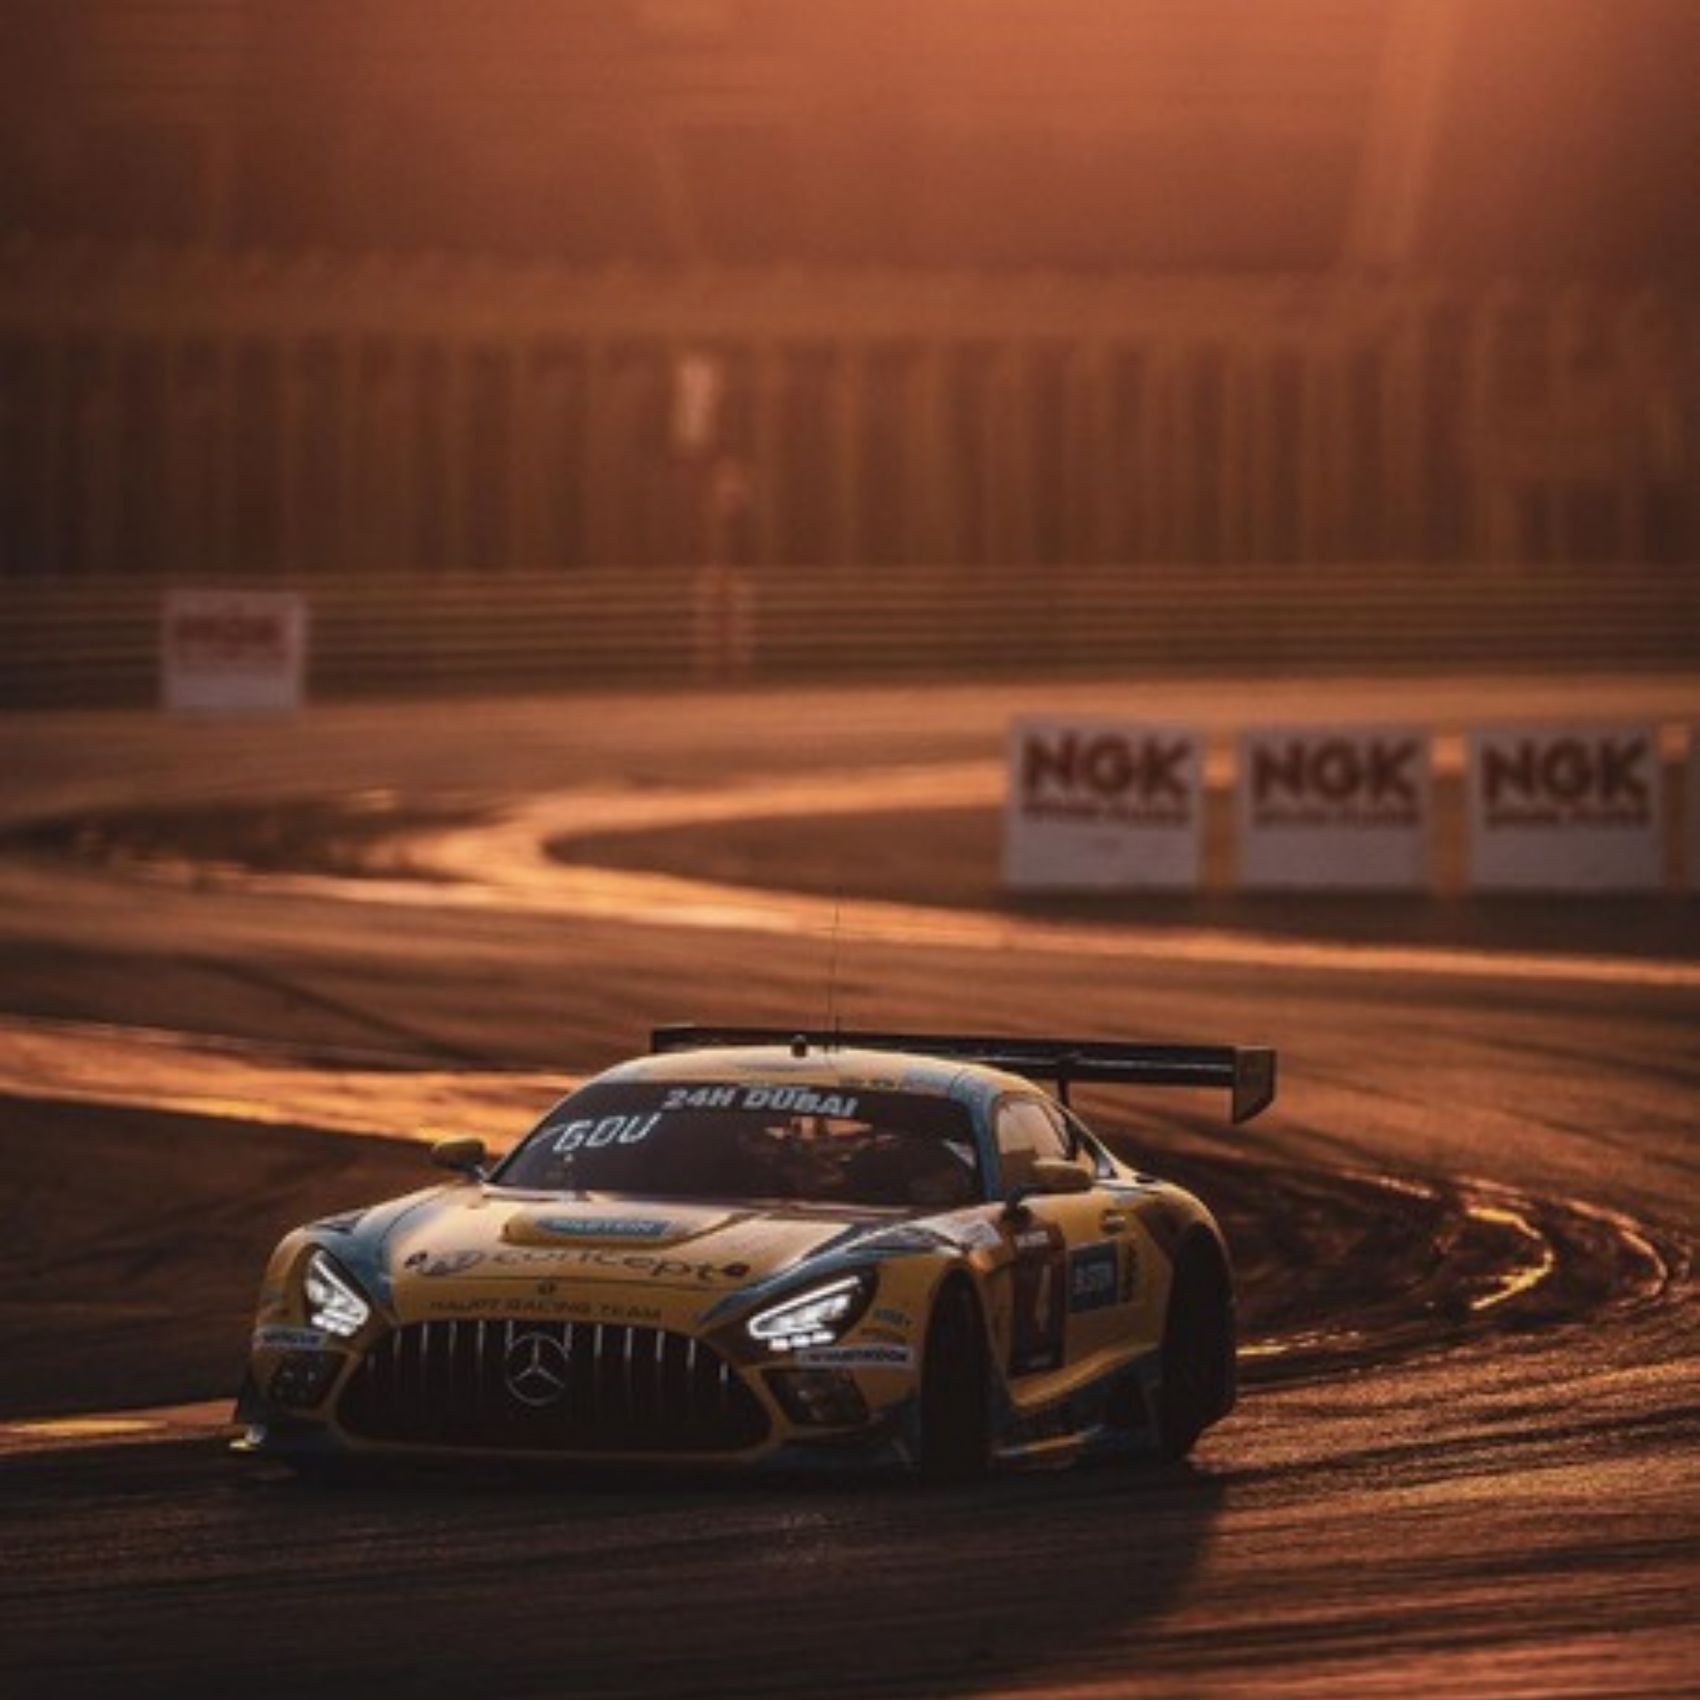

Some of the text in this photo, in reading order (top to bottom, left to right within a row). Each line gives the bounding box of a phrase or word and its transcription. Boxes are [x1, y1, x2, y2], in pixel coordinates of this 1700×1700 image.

[1023, 733, 1191, 798] NGK
[1254, 739, 1418, 801] NGK
[1482, 736, 1650, 803] NGK
[661, 1086, 858, 1116] 24H DUBAI
